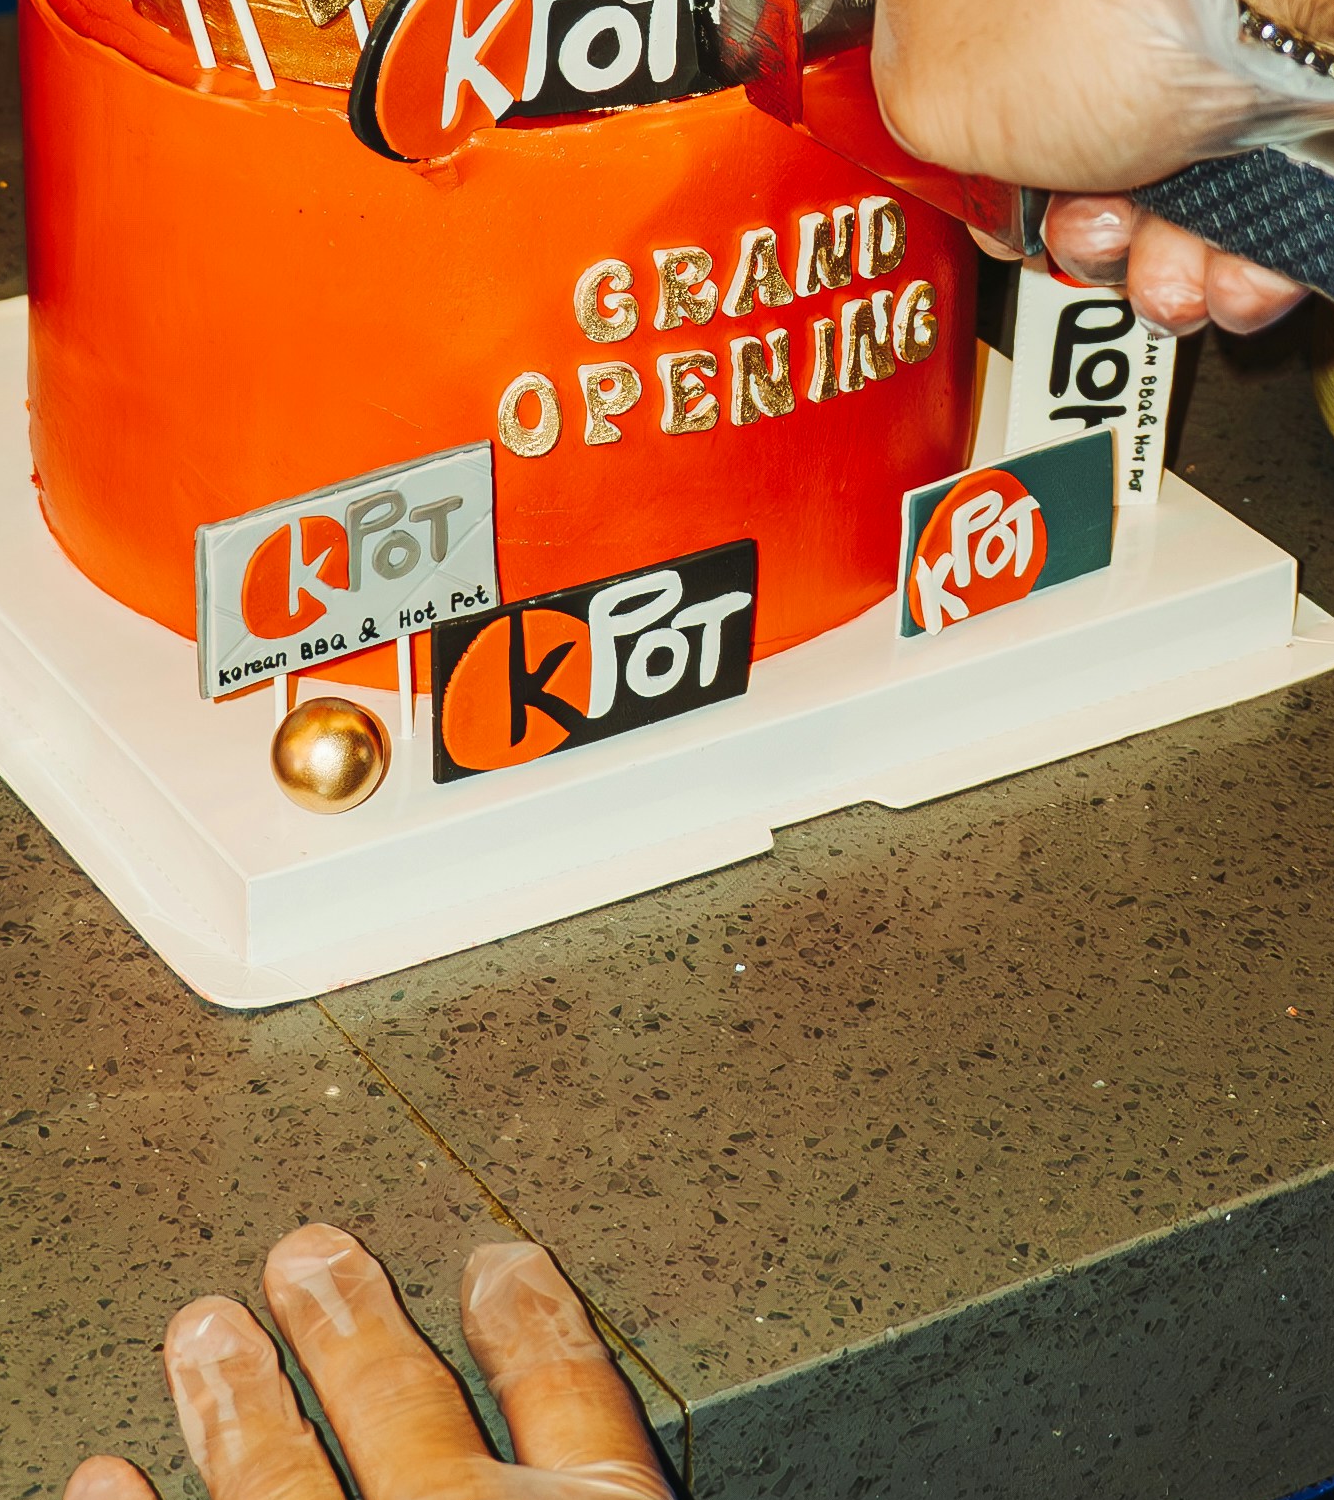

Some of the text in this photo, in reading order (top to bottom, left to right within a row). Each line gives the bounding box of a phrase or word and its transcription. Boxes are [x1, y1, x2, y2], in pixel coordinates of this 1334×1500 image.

[573, 194, 907, 345] GRAND
[497, 279, 940, 459] OPENING
[241, 489, 464, 640] KPOT
[299, 637, 348, 661] BBQ
[358, 617, 381, 642] &
[398, 600, 439, 628] Hot
[450, 585, 491, 614] Pot
[917, 490, 1041, 635] KPOT
[442, 569, 752, 771] KPOT
